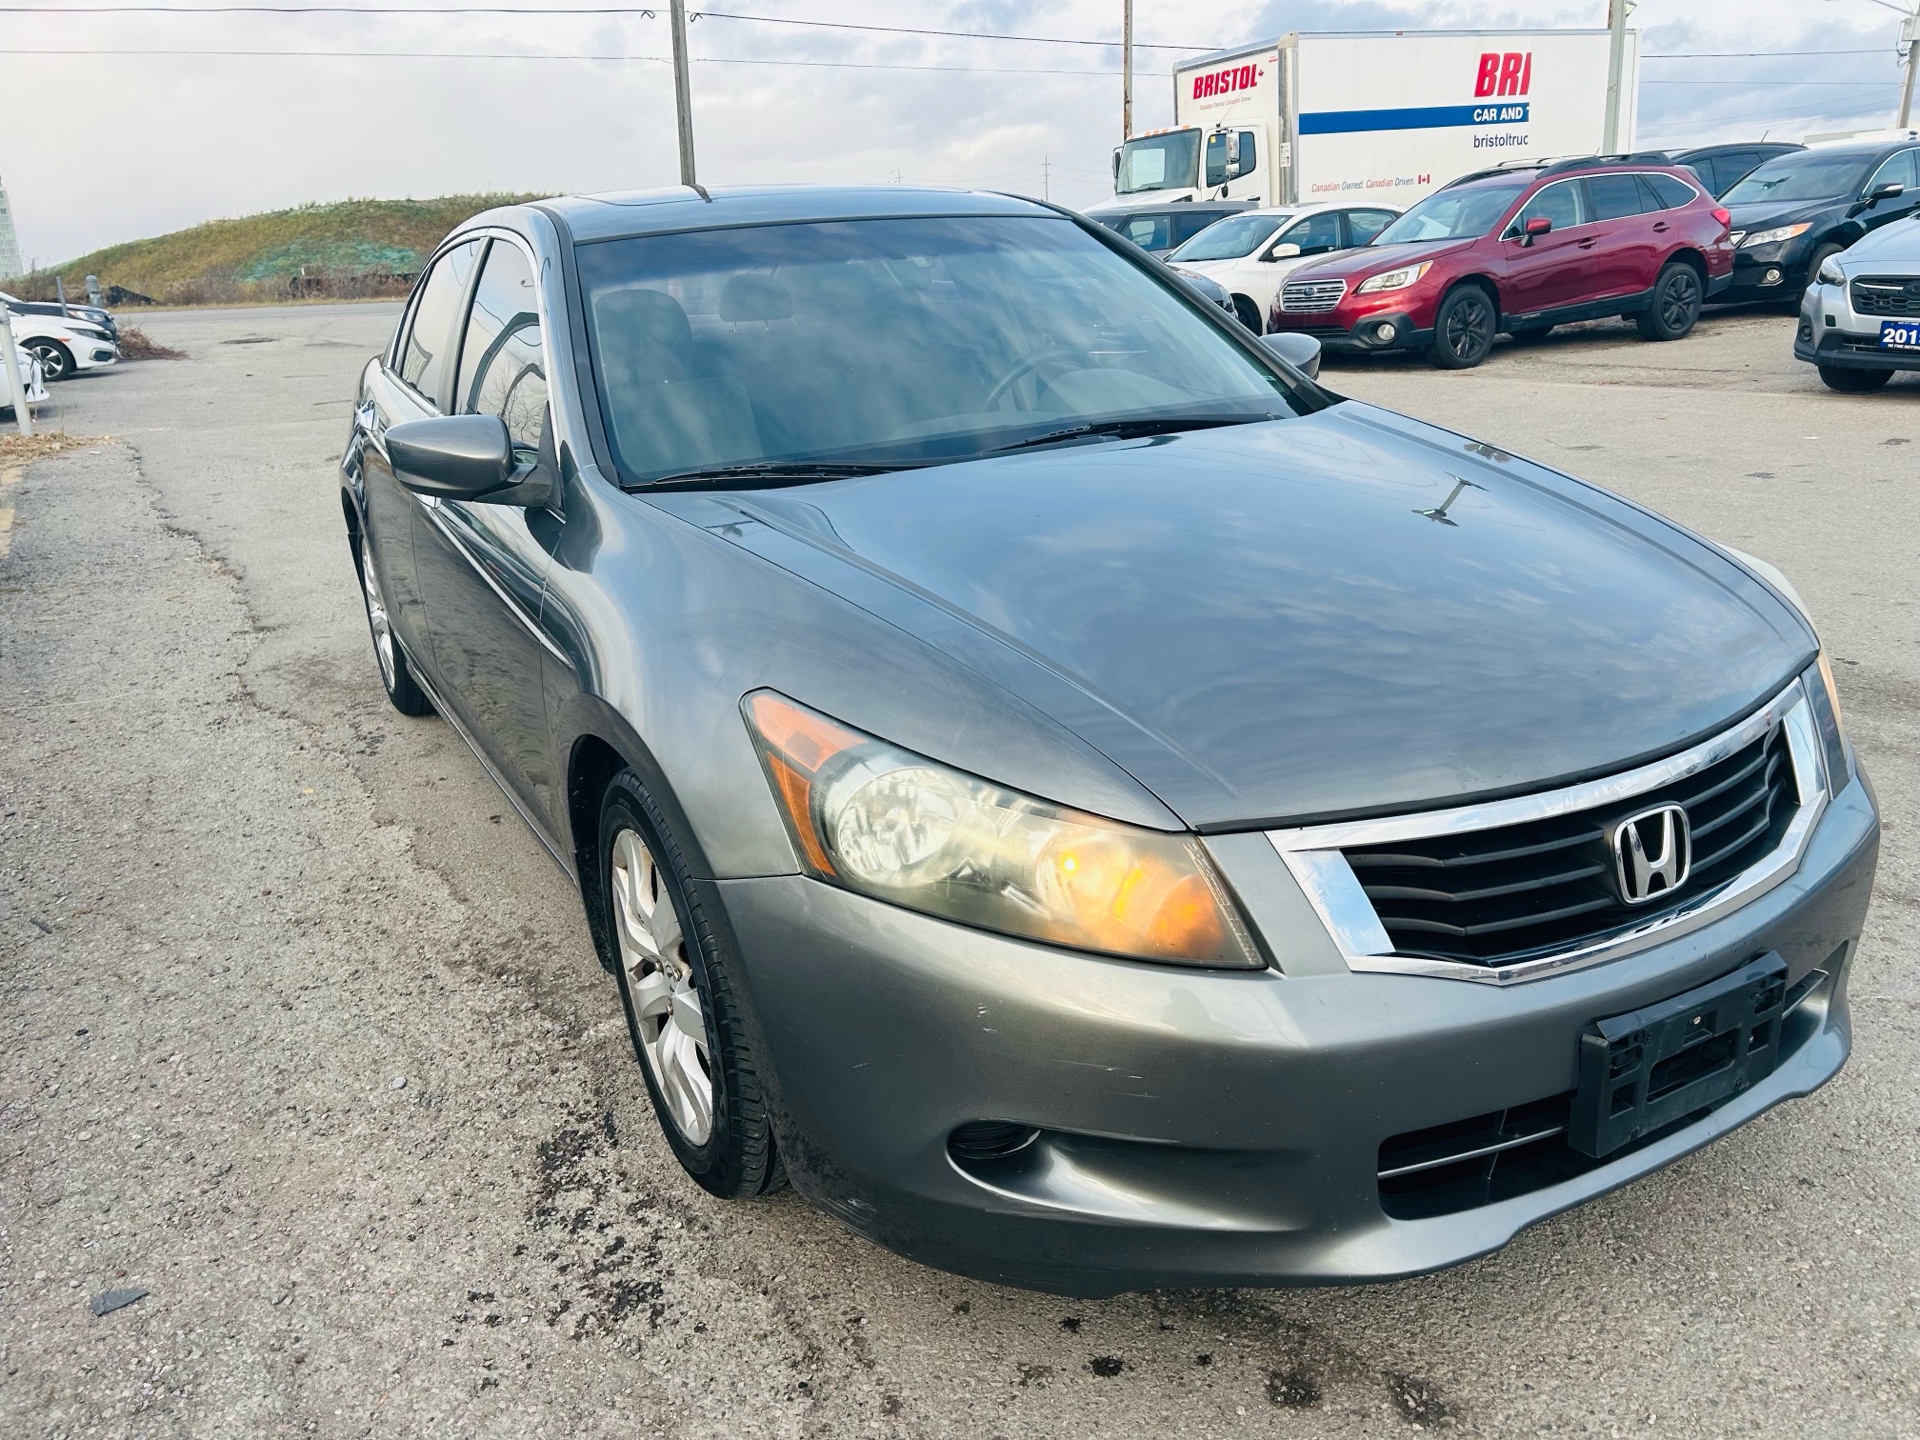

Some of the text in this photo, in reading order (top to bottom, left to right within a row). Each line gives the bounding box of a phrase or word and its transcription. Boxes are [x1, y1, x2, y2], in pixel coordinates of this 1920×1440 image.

[1193, 64, 1258, 100] BRISTOL
[1474, 52, 1532, 97] BRI
[1473, 107, 1523, 122] CAR AND
[1311, 177, 1415, 193] Canadian Owned. Canadian Driven.
[1883, 328, 1920, 344] 201
